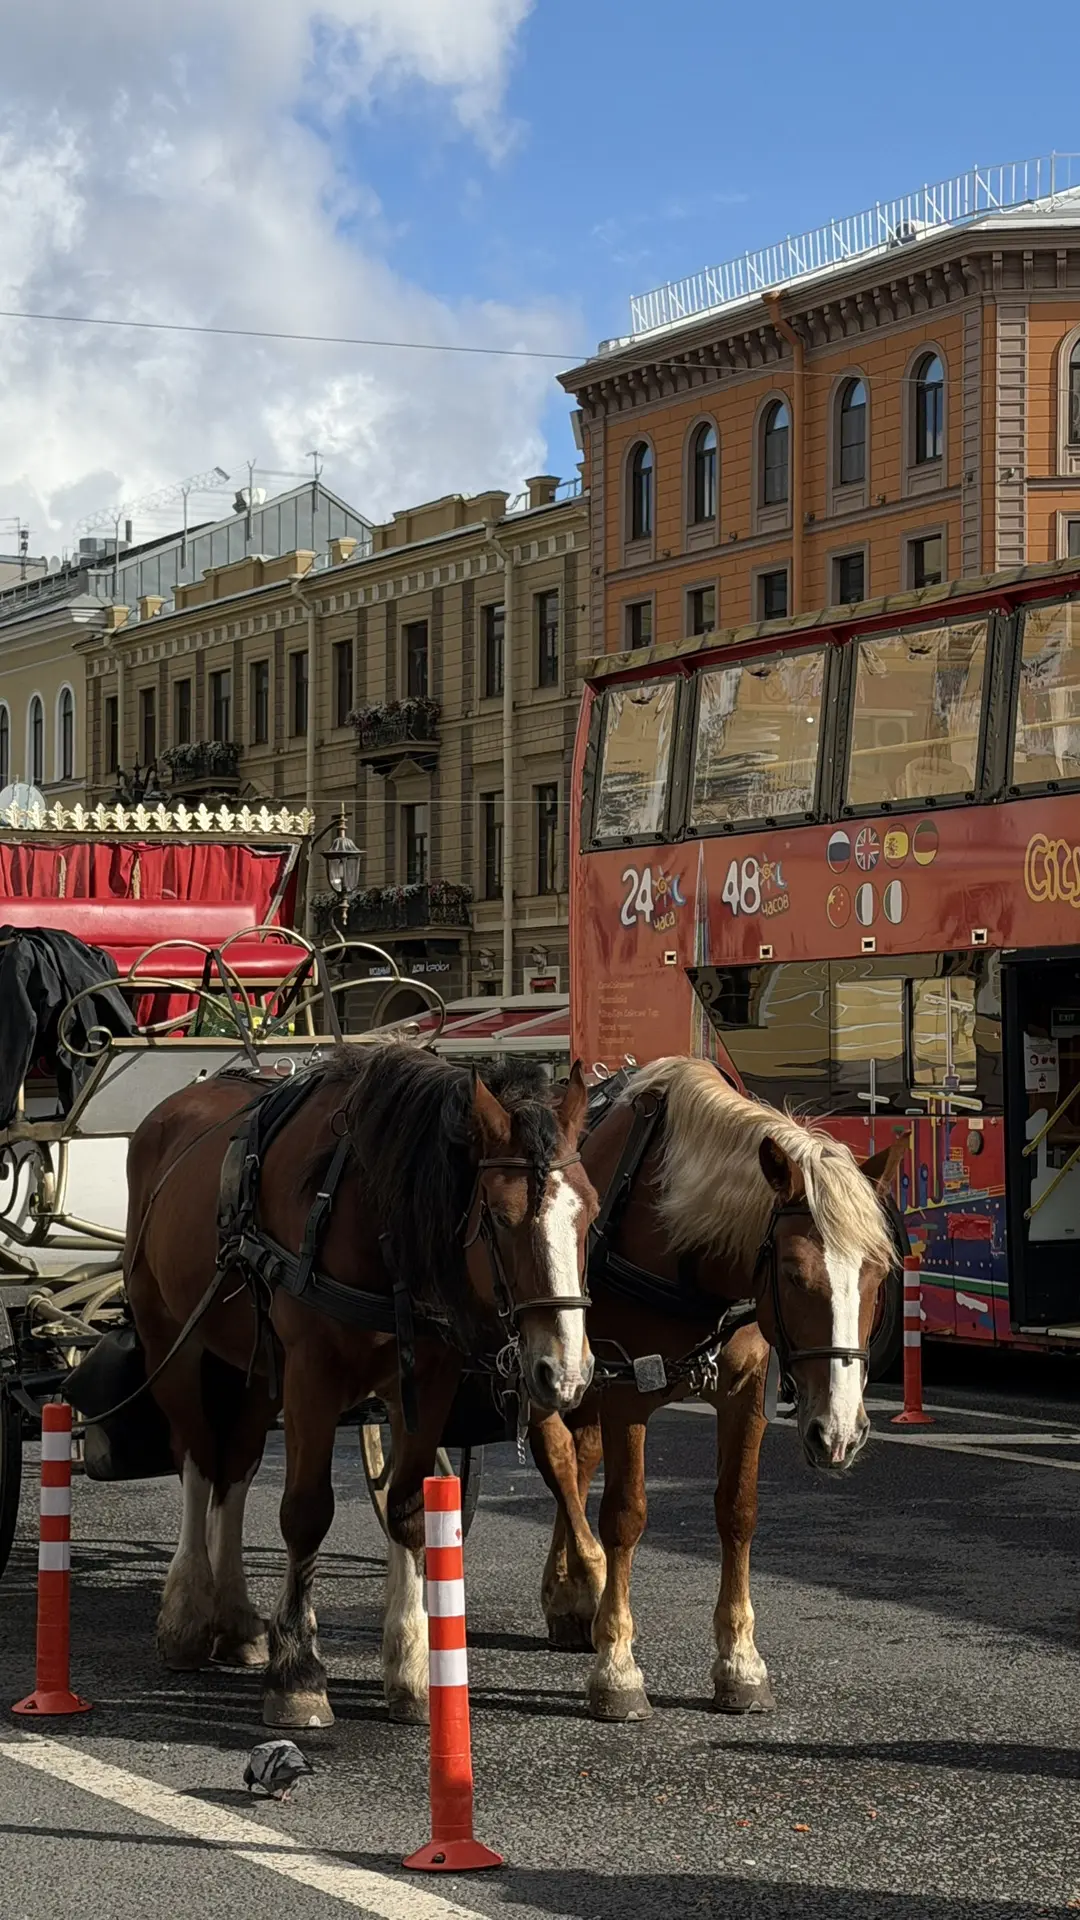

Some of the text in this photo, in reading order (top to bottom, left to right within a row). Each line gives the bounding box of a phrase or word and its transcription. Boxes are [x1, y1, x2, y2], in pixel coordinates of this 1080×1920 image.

[621, 867, 676, 931] 24 часа
[721, 857, 789, 916] 48 часов
[1059, 1013, 1075, 1022] EXIT
